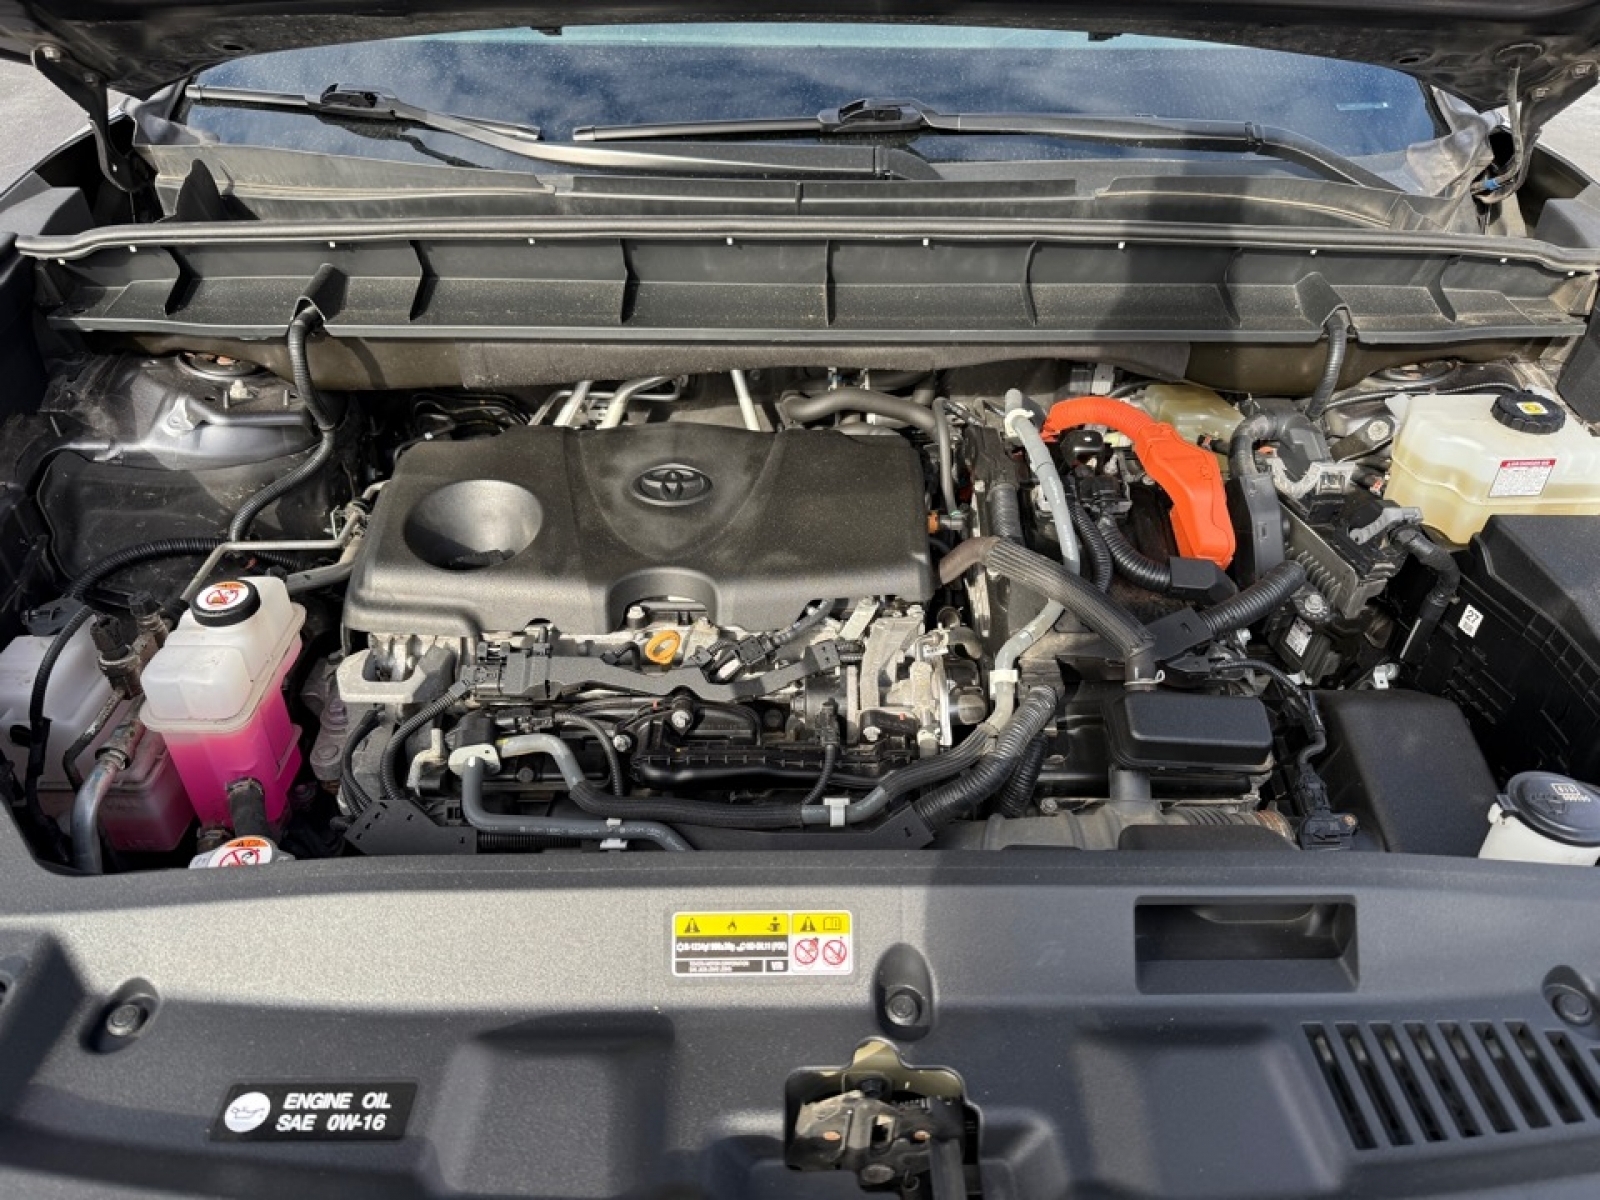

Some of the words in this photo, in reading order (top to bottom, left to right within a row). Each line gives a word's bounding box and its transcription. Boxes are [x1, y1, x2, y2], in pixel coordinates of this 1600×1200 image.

[284, 1091, 354, 1109] ENGINE
[361, 1091, 392, 1109] OIL
[275, 1113, 317, 1131] SAE
[325, 1113, 387, 1131] 0W-16
